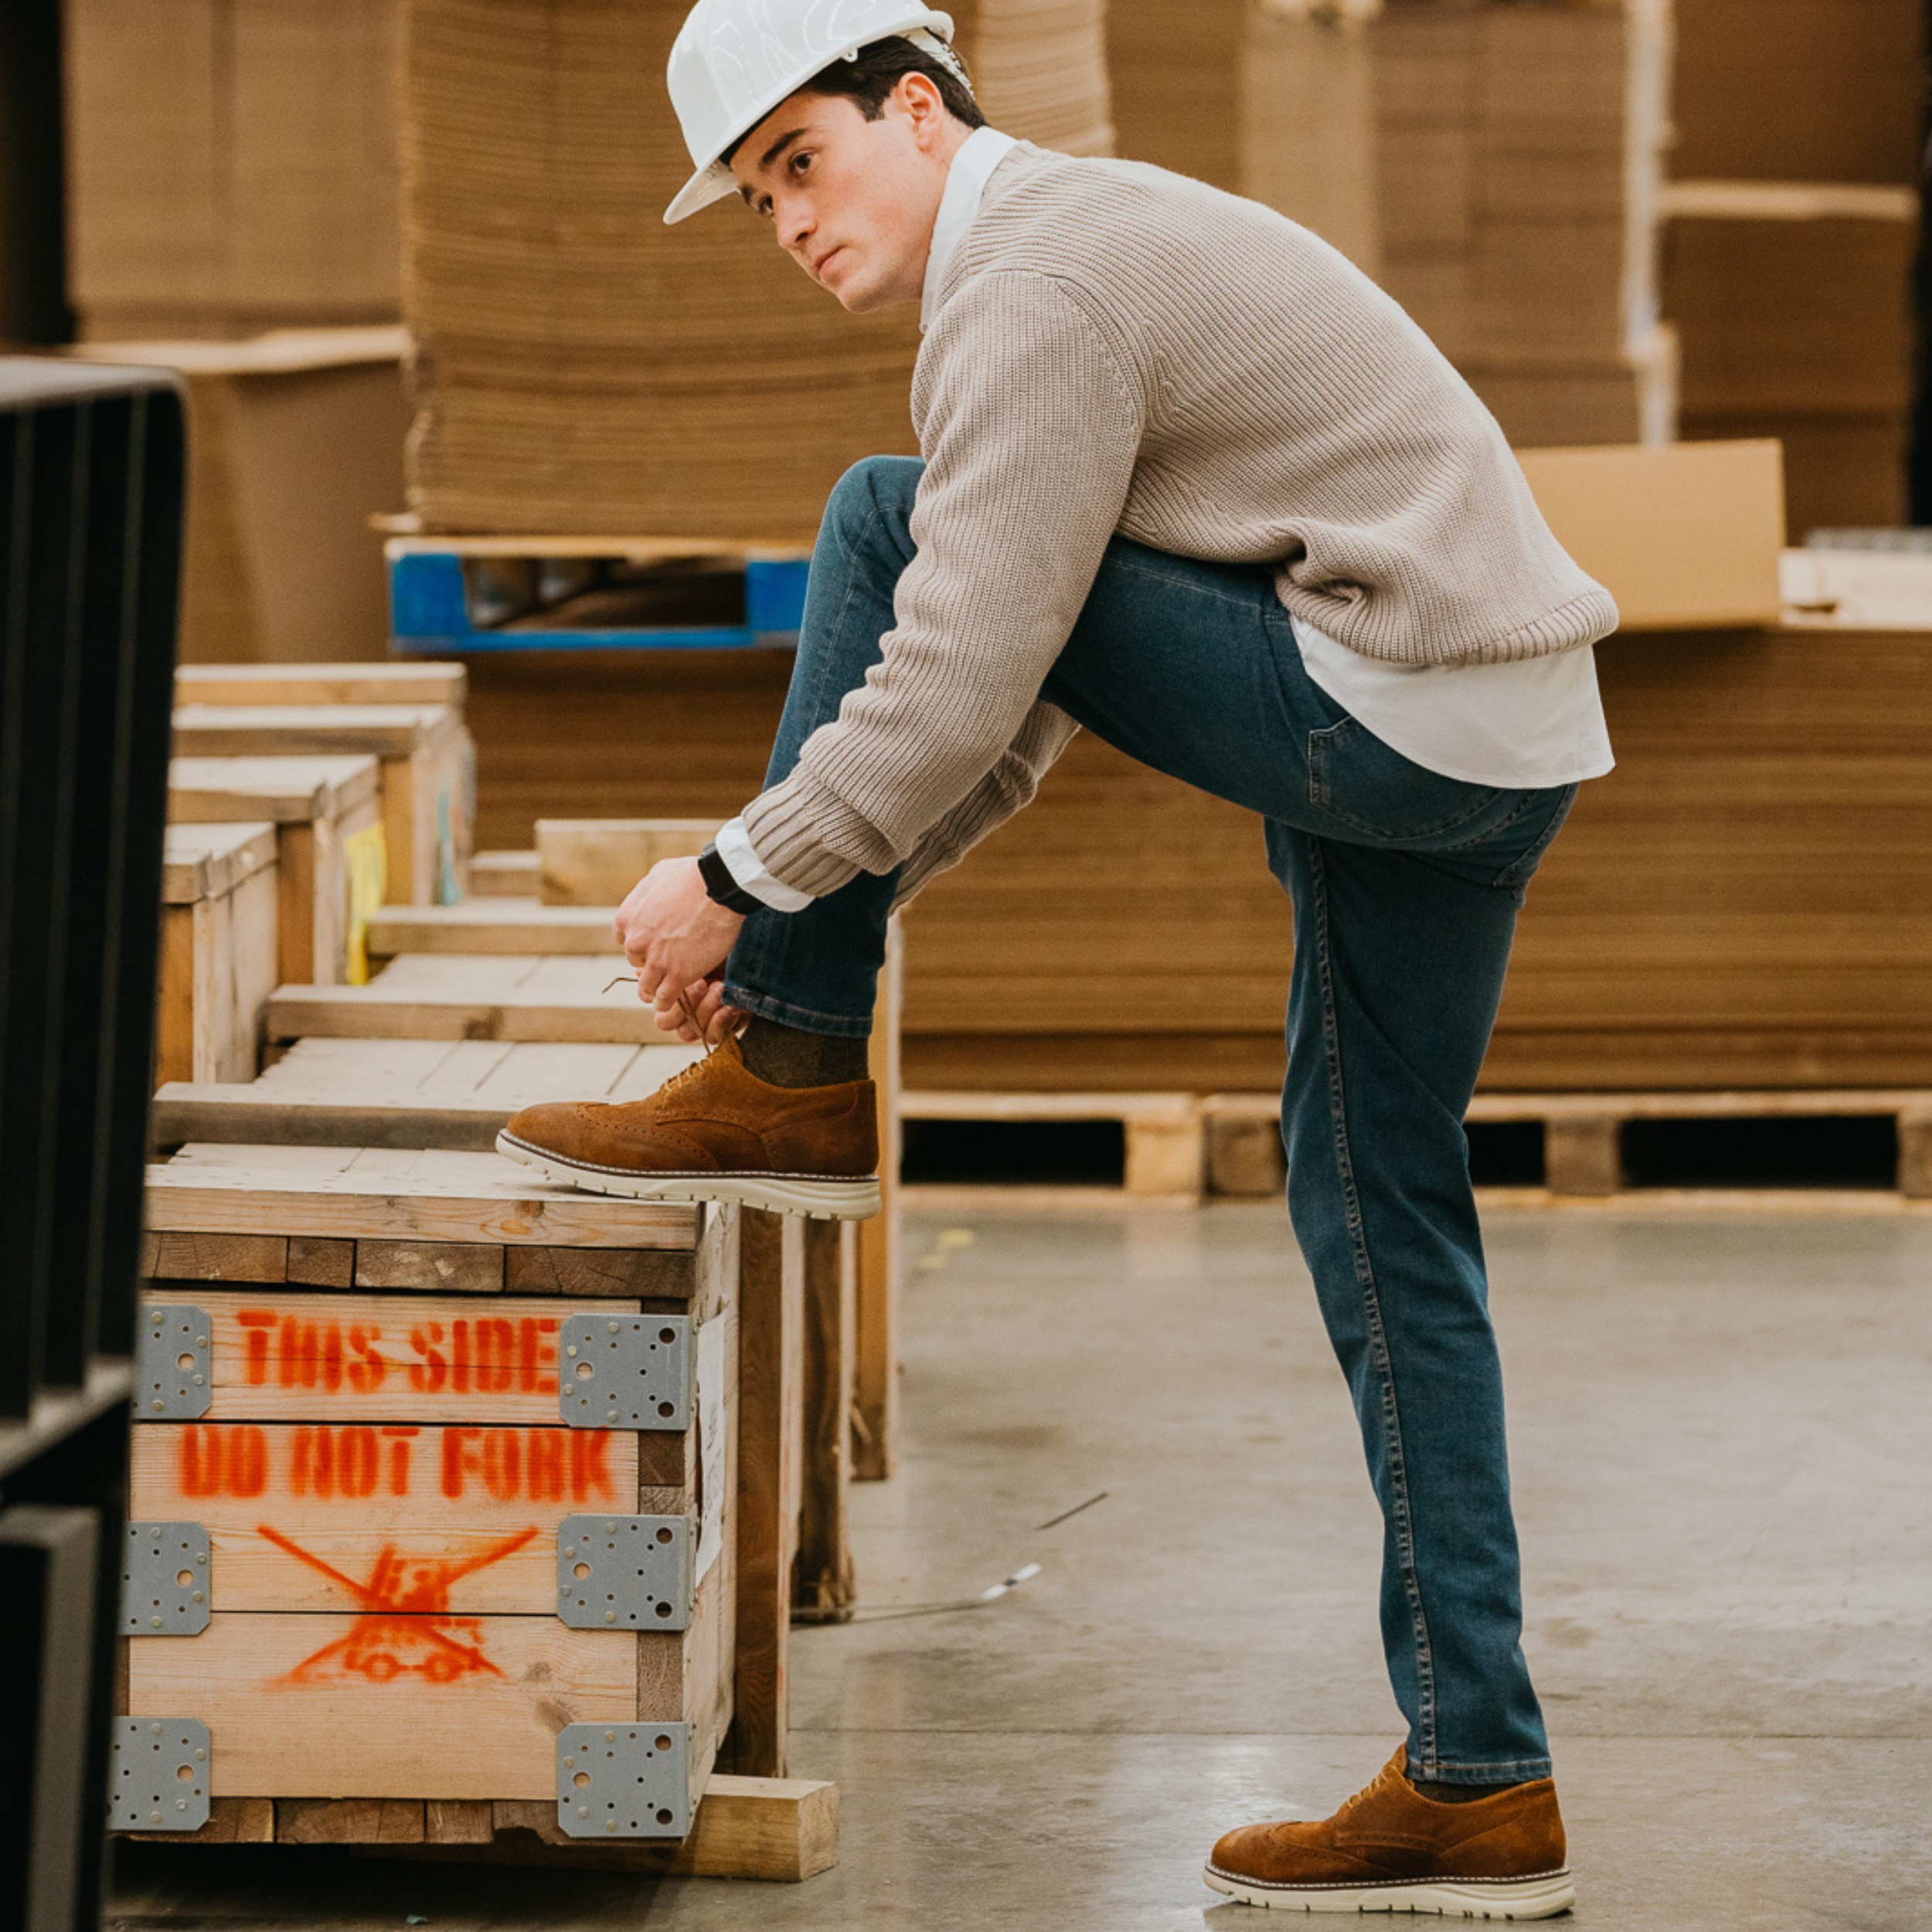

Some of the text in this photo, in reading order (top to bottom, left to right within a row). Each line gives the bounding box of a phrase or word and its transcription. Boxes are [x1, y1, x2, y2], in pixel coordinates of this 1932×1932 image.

[236, 1308, 559, 1393] THIS SIDE
[177, 1424, 268, 1498] DO
[289, 1425, 420, 1500] NOT
[441, 1427, 617, 1503] FORK
